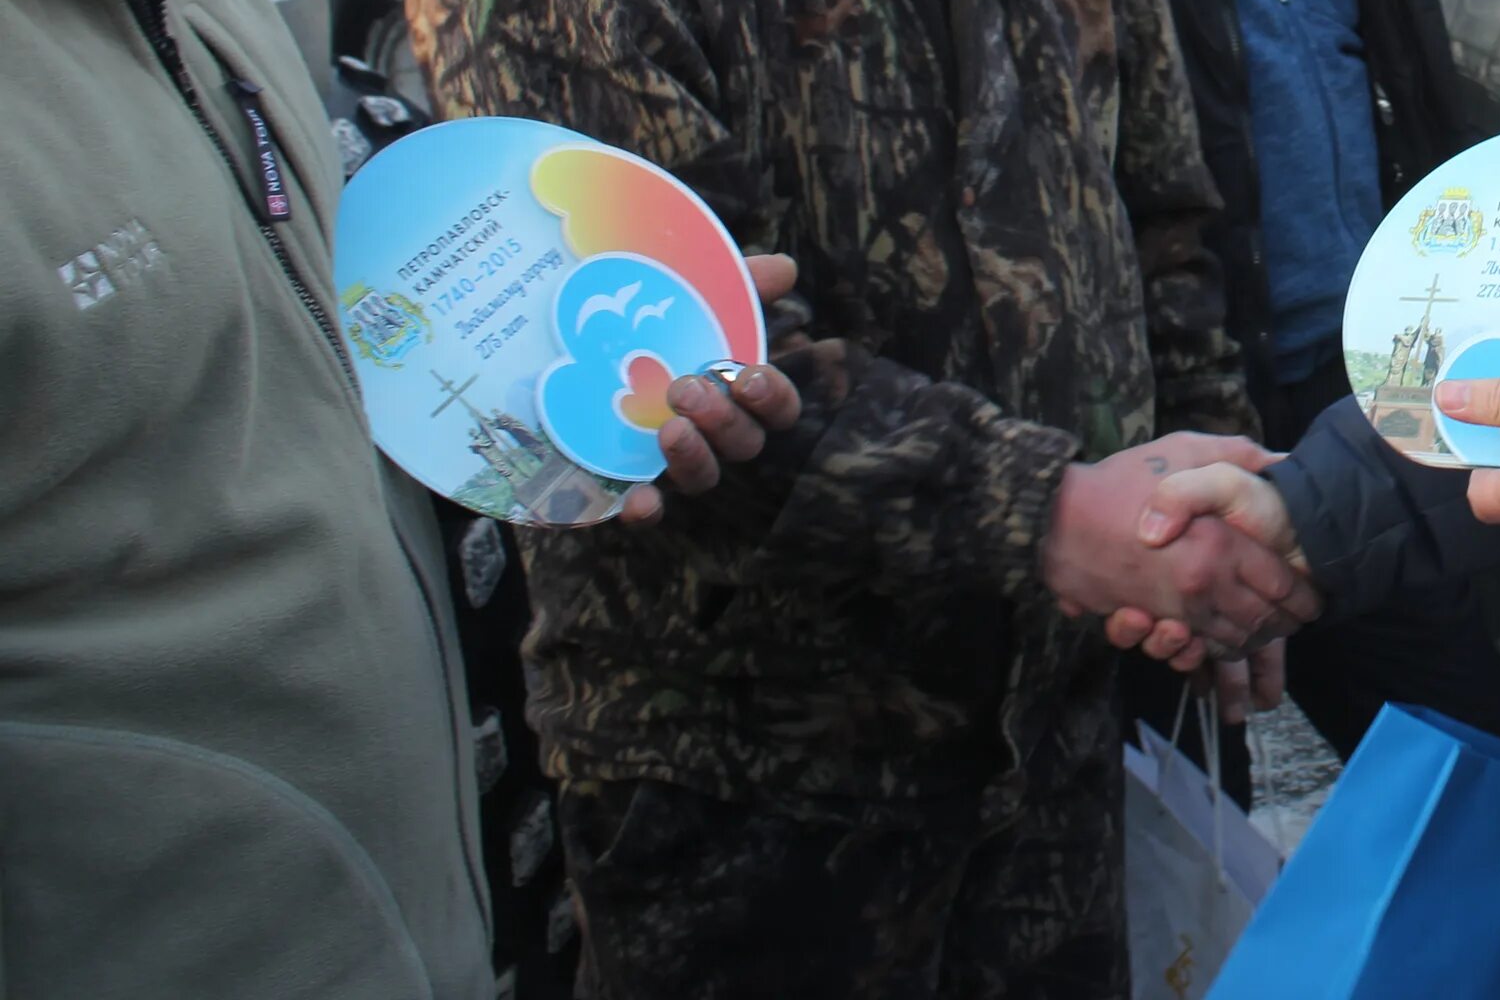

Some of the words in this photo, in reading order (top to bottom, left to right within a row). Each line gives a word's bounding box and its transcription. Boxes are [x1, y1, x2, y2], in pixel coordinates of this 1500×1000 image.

[260, 151, 281, 192] NOVA
[397, 189, 511, 281] ПЕТРОПАВЛОВСК-
[412, 218, 504, 296] КАМЧАТСКИЙ
[454, 278, 528, 340] Любимому
[520, 247, 564, 284] городу
